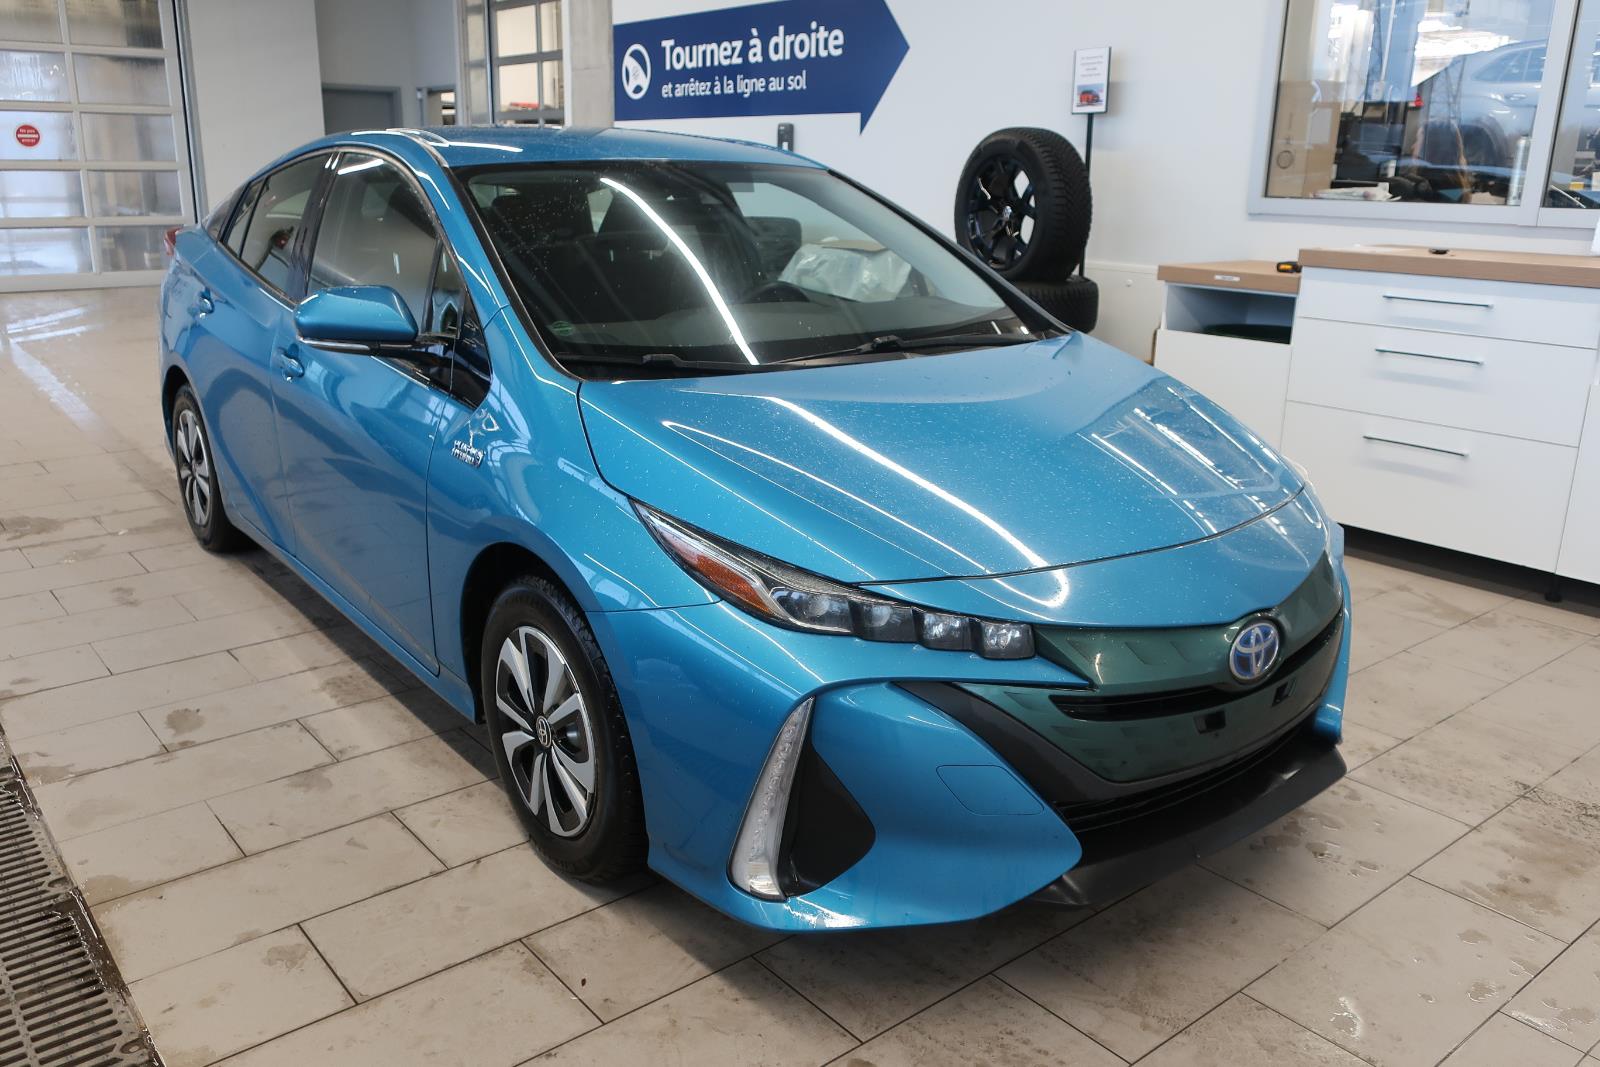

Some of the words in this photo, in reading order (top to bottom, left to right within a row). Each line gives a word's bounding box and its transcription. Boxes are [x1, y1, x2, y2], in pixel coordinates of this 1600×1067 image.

[661, 39, 743, 71] Tournez
[748, 28, 763, 63] à
[768, 21, 845, 62] droite
[661, 82, 673, 98] et
[675, 78, 711, 97] arrêtez
[714, 76, 721, 95] à
[723, 75, 734, 94] la
[737, 74, 766, 98] ligne
[768, 75, 785, 92] au
[787, 69, 807, 90] sol
